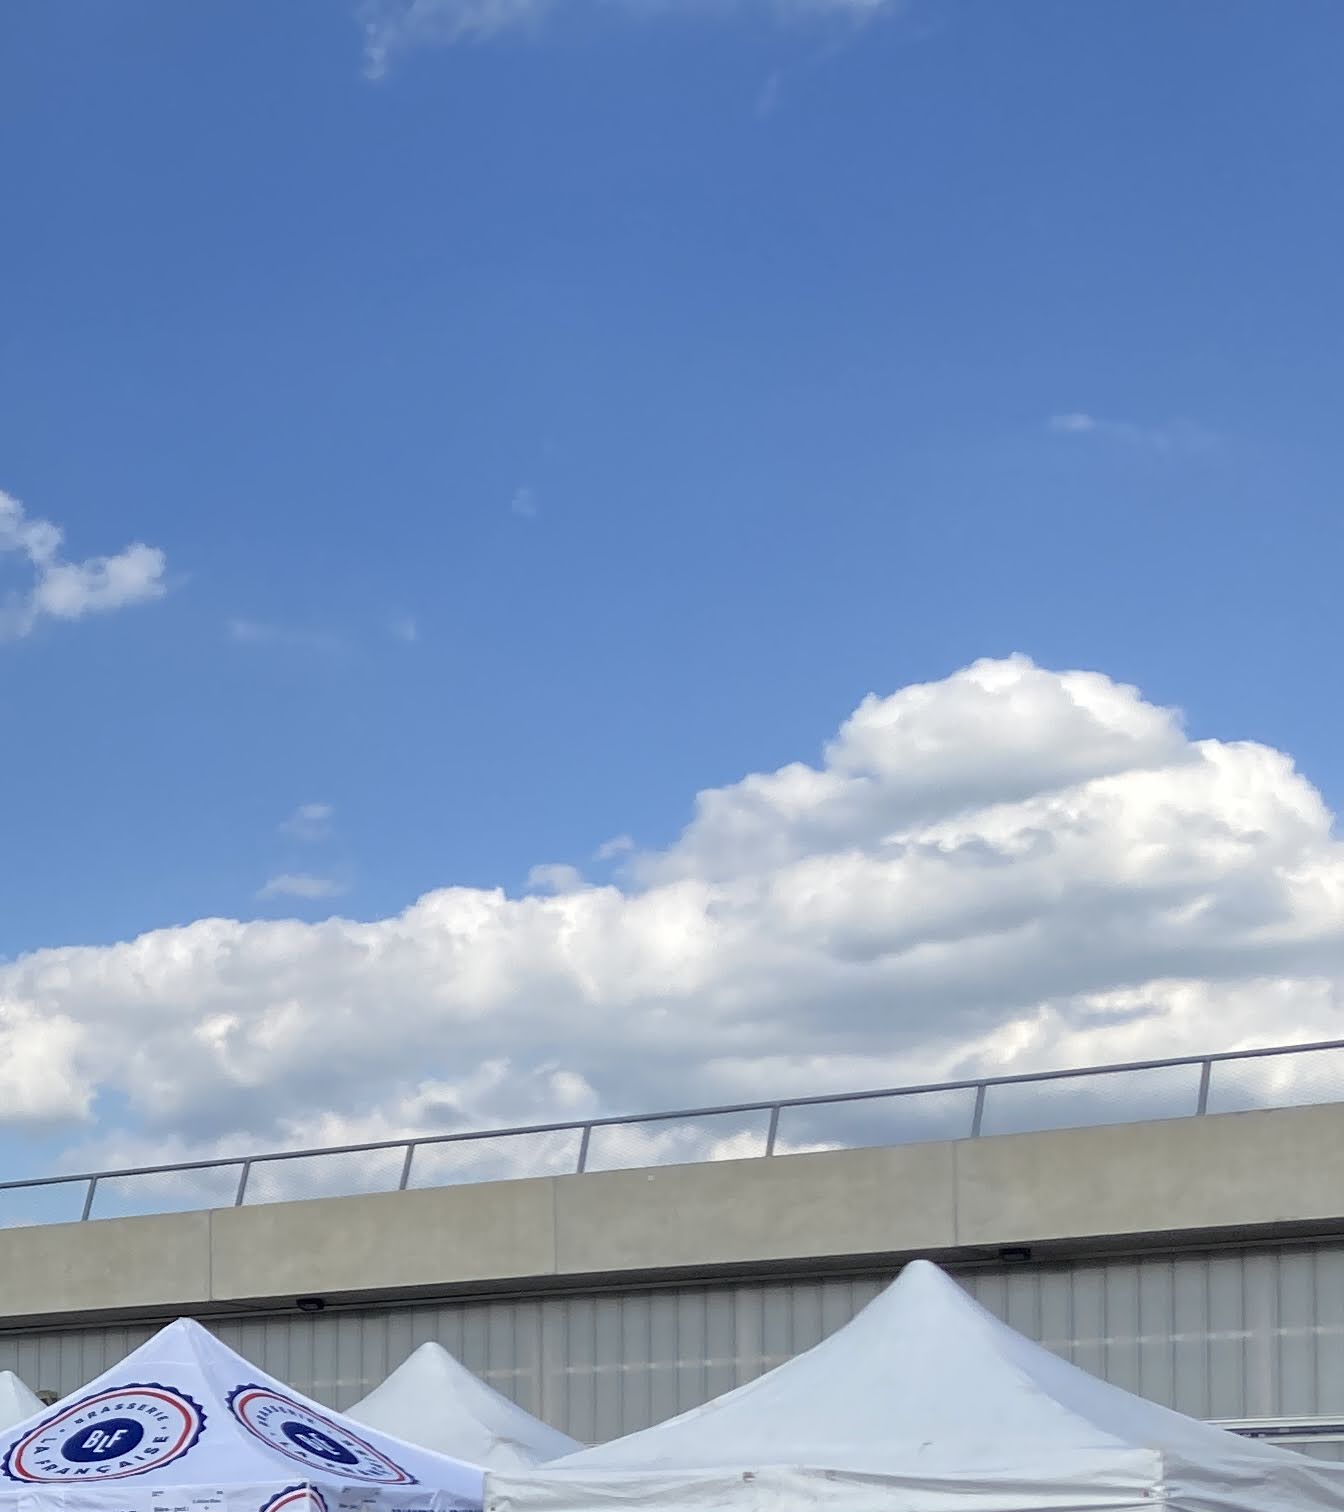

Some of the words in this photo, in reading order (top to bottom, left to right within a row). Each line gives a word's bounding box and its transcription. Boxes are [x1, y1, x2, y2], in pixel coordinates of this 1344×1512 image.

[74, 1402, 169, 1425] BRASSERIE
[34, 1437, 58, 1455] LA
[81, 1429, 128, 1453] BLF
[34, 1436, 169, 1475] FRANÇAISE
